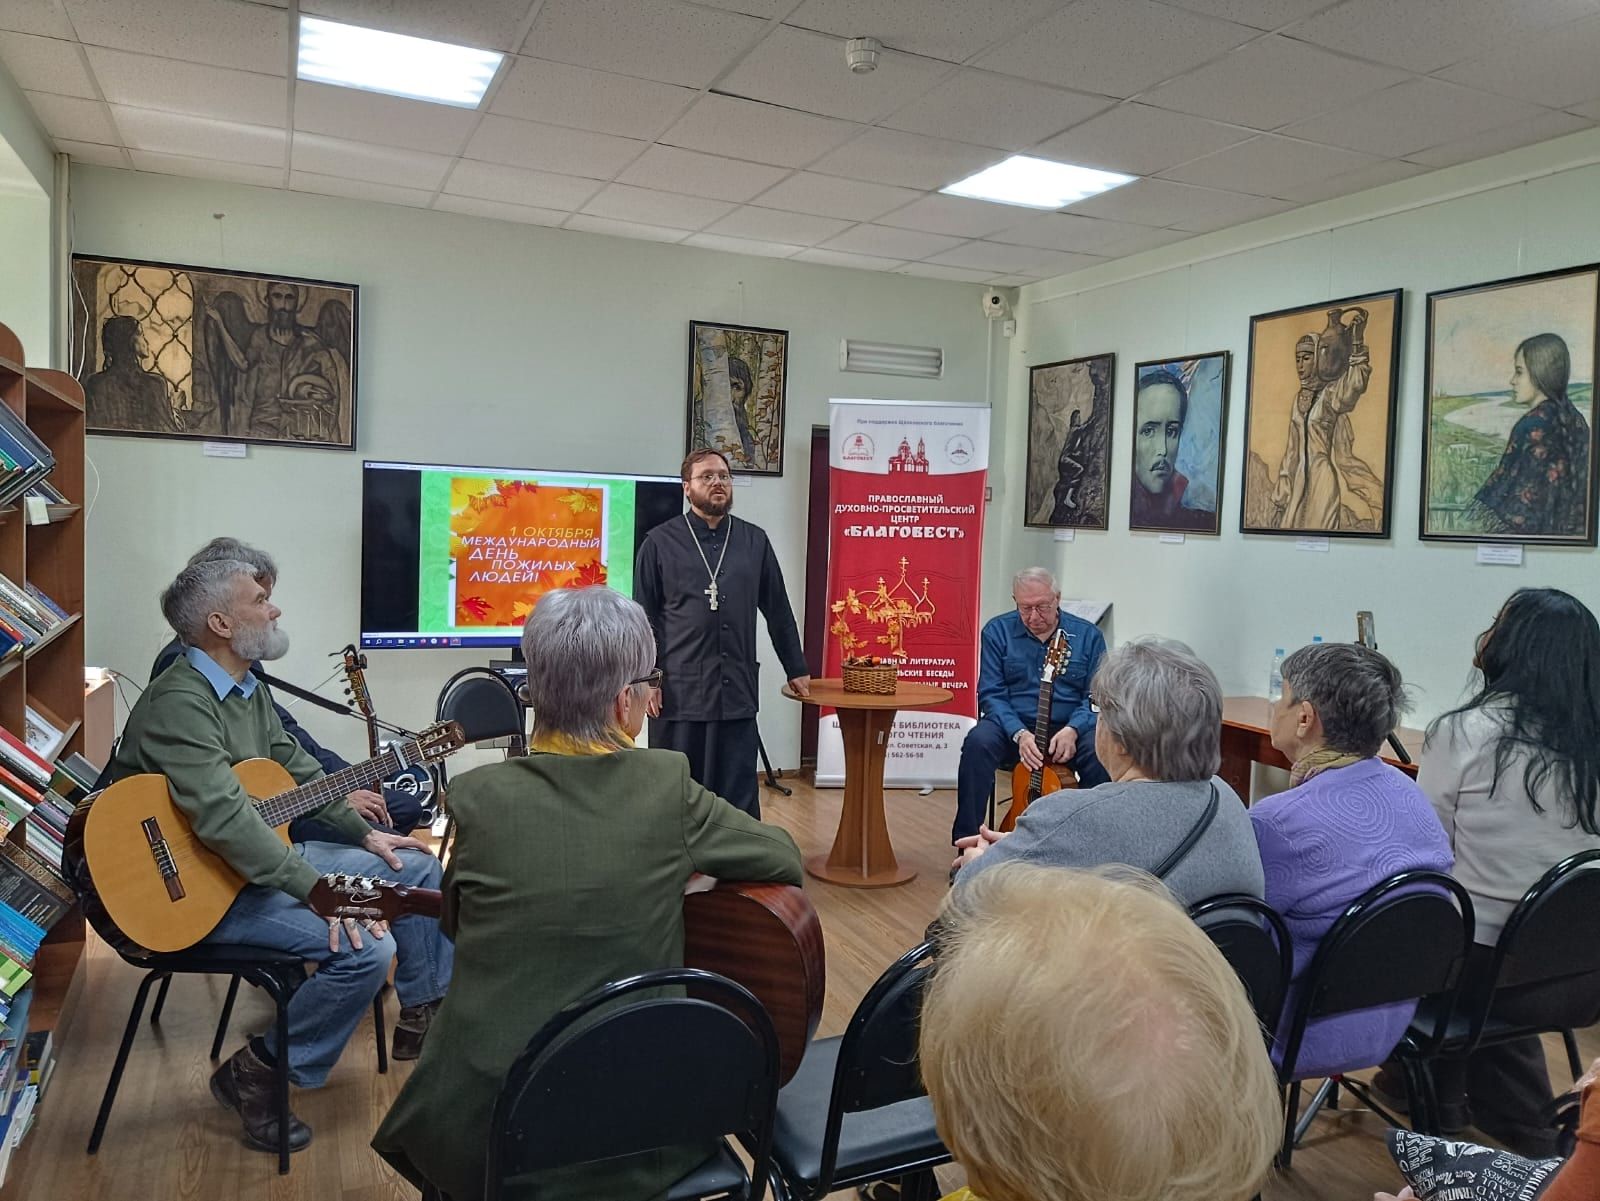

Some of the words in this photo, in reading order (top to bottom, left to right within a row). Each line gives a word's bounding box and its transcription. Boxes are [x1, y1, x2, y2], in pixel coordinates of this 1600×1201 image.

[868, 494, 944, 504] ПРАВОСЛАВНЫЙ
[835, 504, 976, 514] ДУХОВНО-ПРОСВЕТИТЕЛЬСКИЙ
[890, 515, 920, 524] ЦЕНТР
[509, 526, 517, 537] 1
[523, 526, 594, 538] ОКТЯБРЯ
[843, 525, 965, 539] «БЛАГОВЕСТ»
[461, 535, 601, 548] МЕЖДУНАРОДНЫЙ
[468, 547, 519, 560] ДЕНЬ
[491, 559, 577, 571] ПОЖИЛЫХ
[469, 570, 539, 583] ЛЮДЕЙ!
[909, 658, 956, 666] ЛИТЕРАТУРА
[926, 670, 955, 678] БЕСЕДЫ
[941, 681, 969, 689] ВЕЧЕРА
[898, 721, 961, 730] БИБЛИОТЕКА
[907, 731, 944, 739] ЧТЕНИЯ
[1483, 1168, 1521, 1191] FORTRESS
[1481, 1175, 1516, 1199] PAUL
